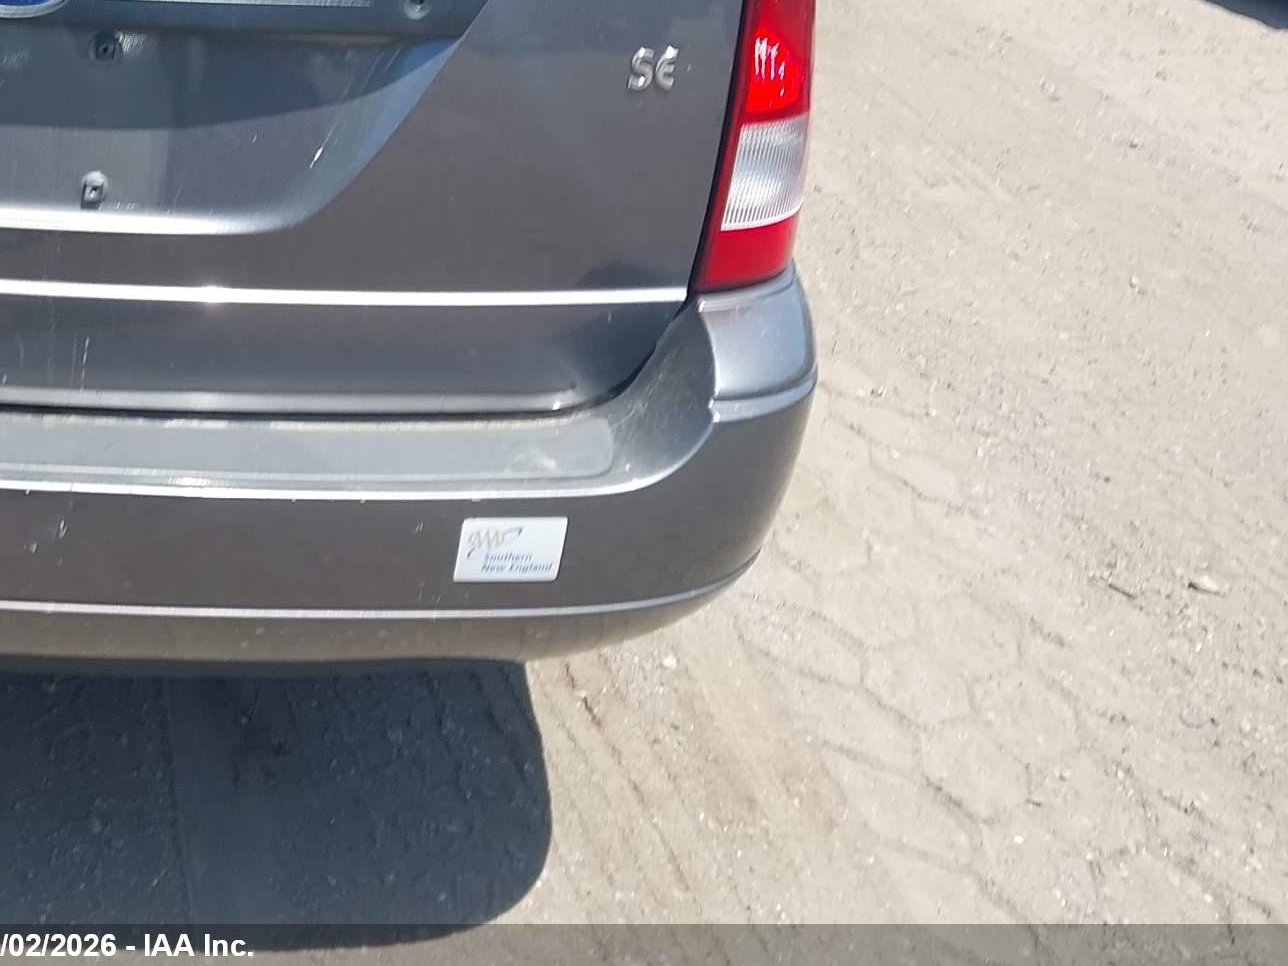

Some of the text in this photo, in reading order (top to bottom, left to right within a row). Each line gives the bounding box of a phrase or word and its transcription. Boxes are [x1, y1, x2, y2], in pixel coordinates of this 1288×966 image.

[627, 45, 679, 91] SE
[481, 561, 553, 574] New England
